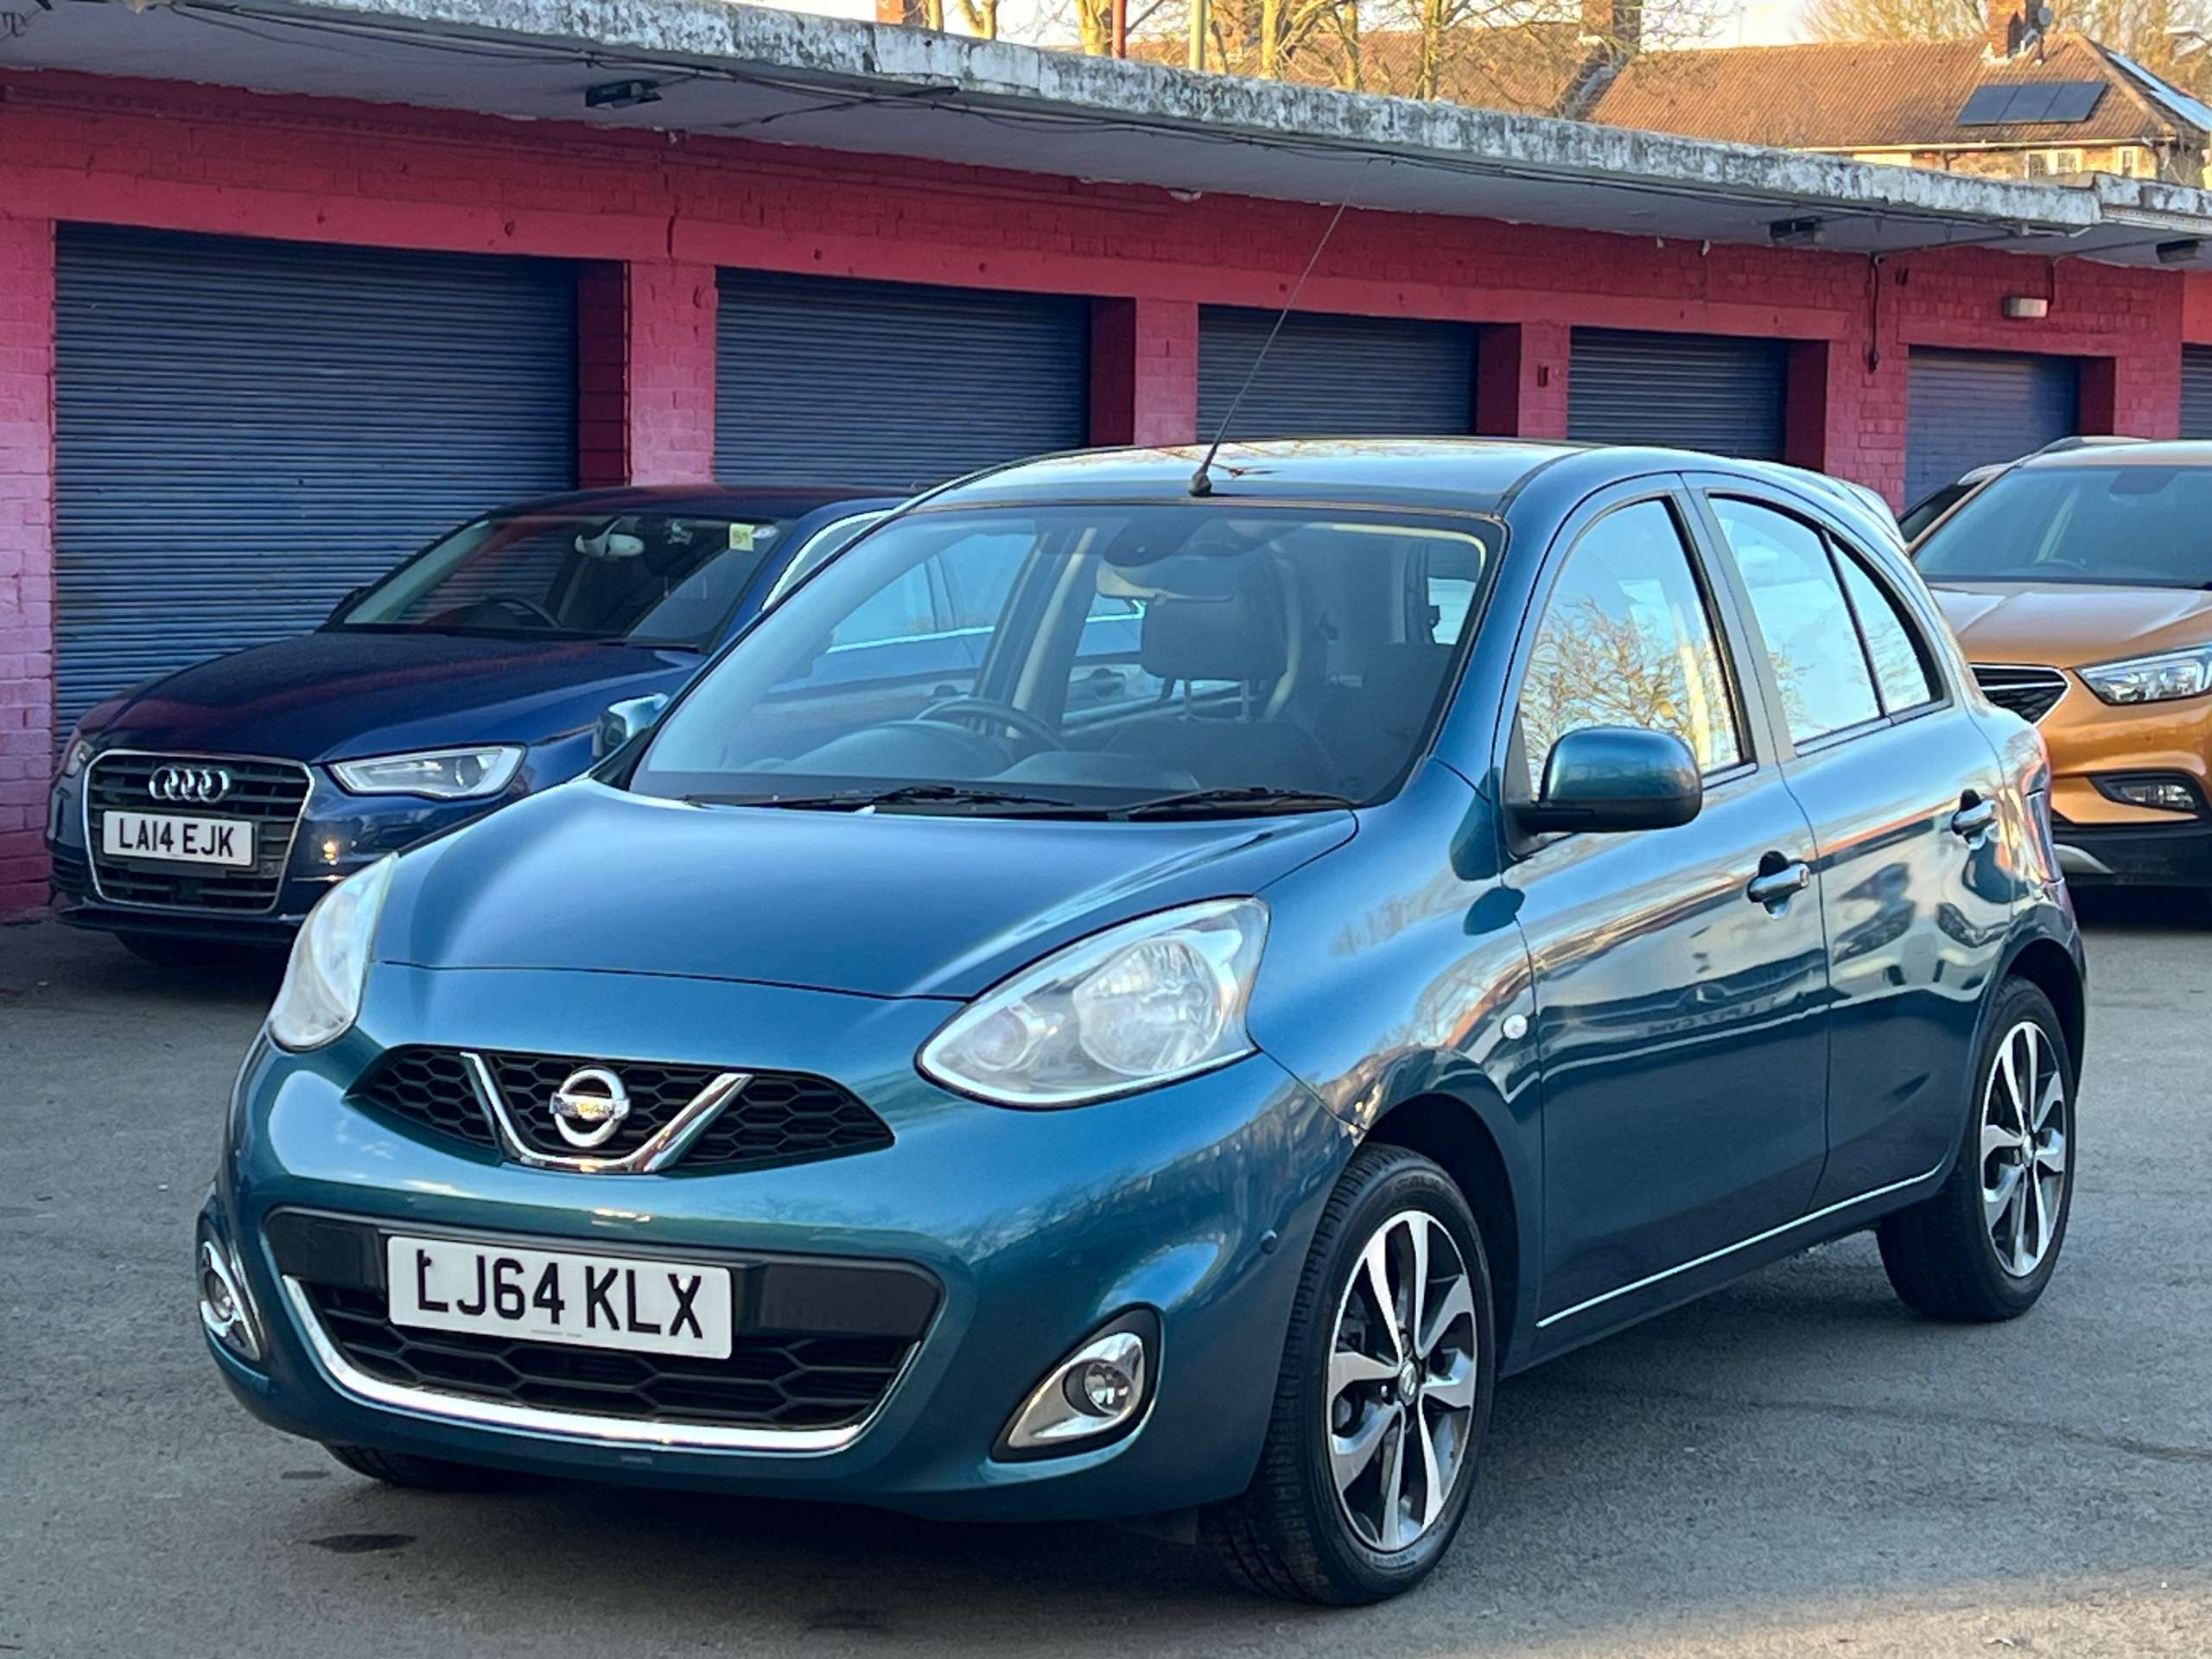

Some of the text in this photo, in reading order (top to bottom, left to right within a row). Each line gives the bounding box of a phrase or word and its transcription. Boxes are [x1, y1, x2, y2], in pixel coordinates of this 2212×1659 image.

[118, 817, 235, 858] LA14 EJK
[416, 1249, 703, 1339] LJ64 KLX
